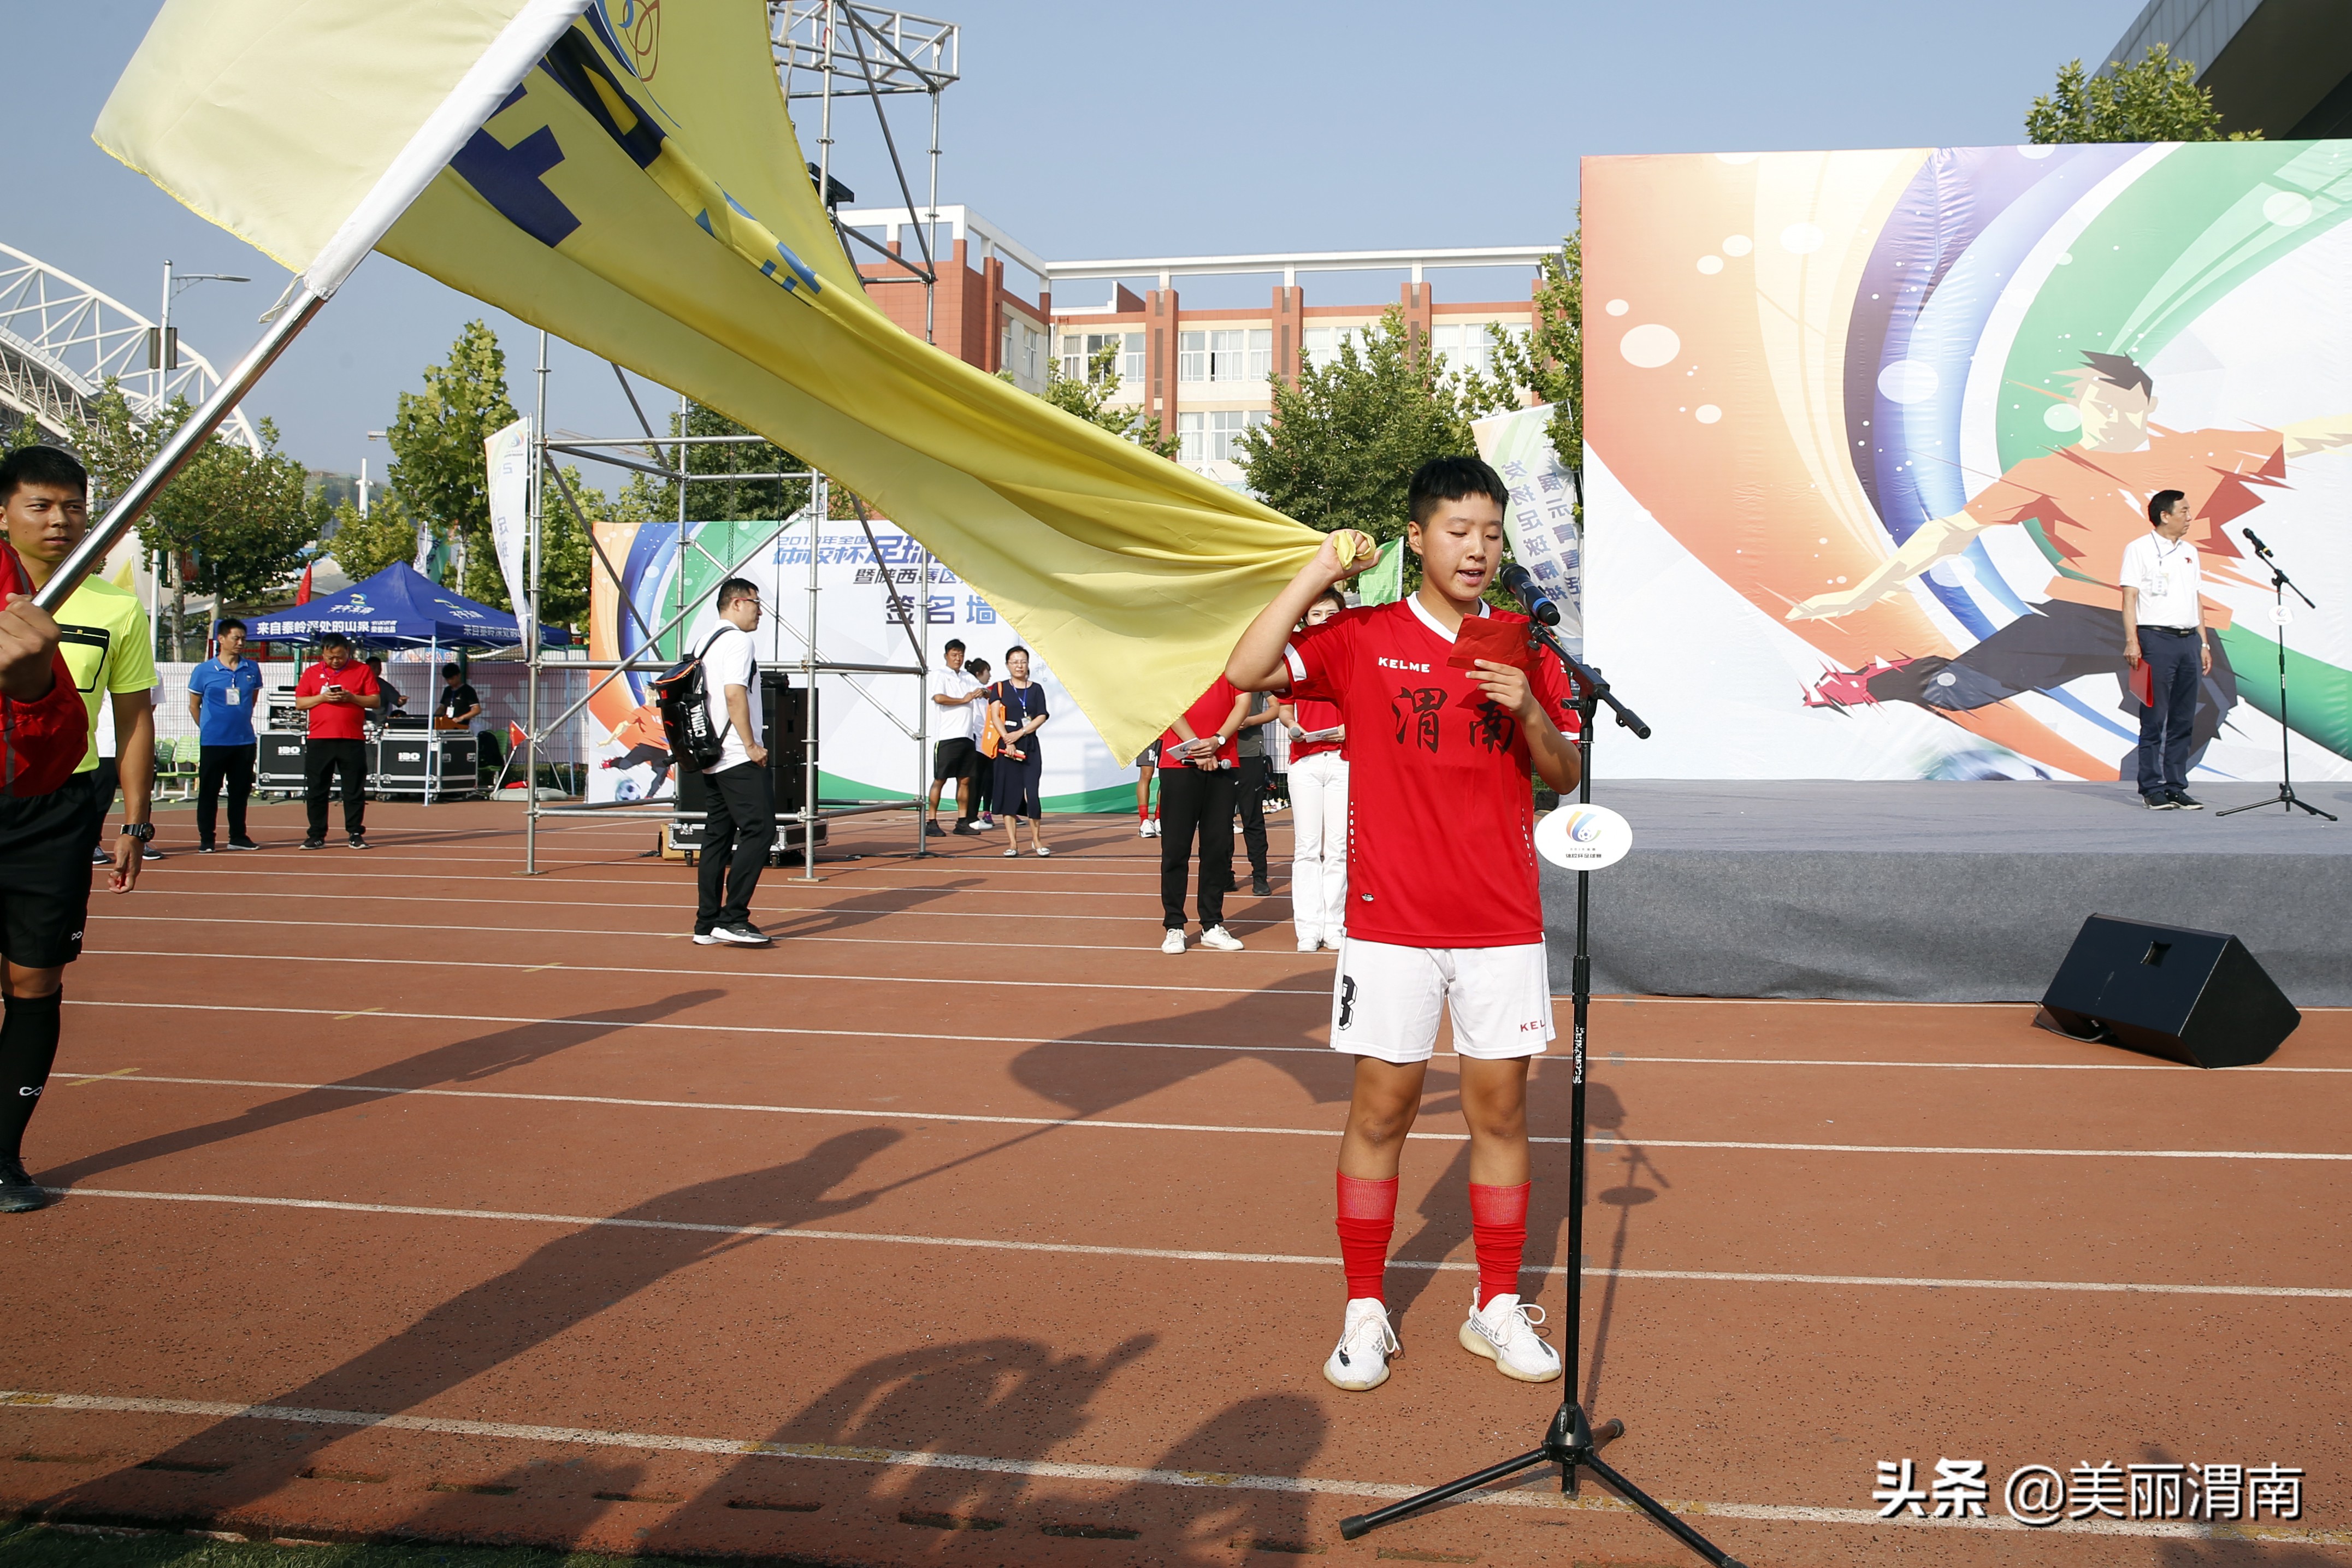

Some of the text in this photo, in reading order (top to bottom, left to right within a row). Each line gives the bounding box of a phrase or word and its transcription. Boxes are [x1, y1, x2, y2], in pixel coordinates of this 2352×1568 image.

[886, 595, 996, 624] 签名墙
[256, 620, 370, 636] 来自秦岭深处的山泉
[1378, 656, 1430, 673] KELME
[690, 704, 707, 738] CHINA
[1391, 687, 1516, 755] 渭南
